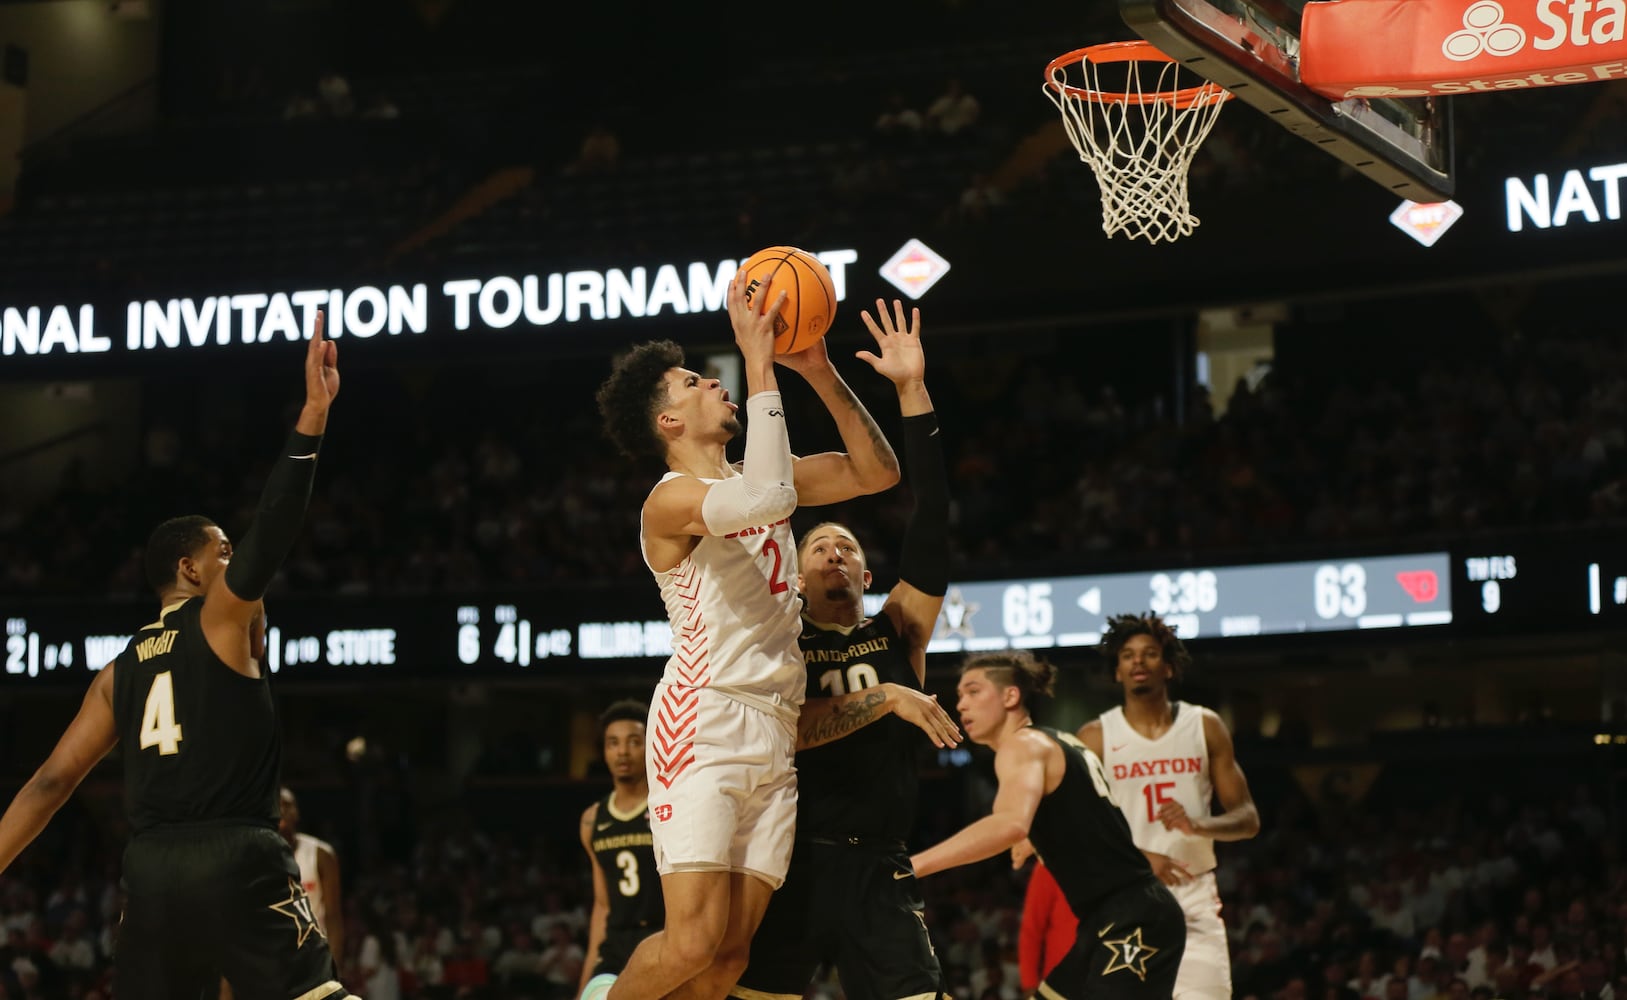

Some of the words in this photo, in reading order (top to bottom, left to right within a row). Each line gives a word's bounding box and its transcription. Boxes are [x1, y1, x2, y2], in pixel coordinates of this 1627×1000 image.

[1432, 71, 1588, 93] State
[1592, 63, 1627, 79] F
[1505, 163, 1627, 232] NAT
[0, 304, 112, 355] NAL
[126, 284, 428, 350] INVITATION
[443, 249, 859, 330] TOURNAMT
[762, 538, 789, 595] 2
[1003, 584, 1053, 636] 65
[1150, 571, 1218, 614] 3:36
[1314, 563, 1367, 619] 63
[1482, 580, 1500, 614] 9
[6, 634, 27, 674] 2
[326, 628, 397, 666] STUTE
[457, 623, 480, 664] 6
[494, 621, 517, 663] 4
[140, 670, 183, 756] 4
[1113, 757, 1203, 780] DAYTON
[616, 850, 640, 897] 3
[1123, 943, 1141, 965] V
